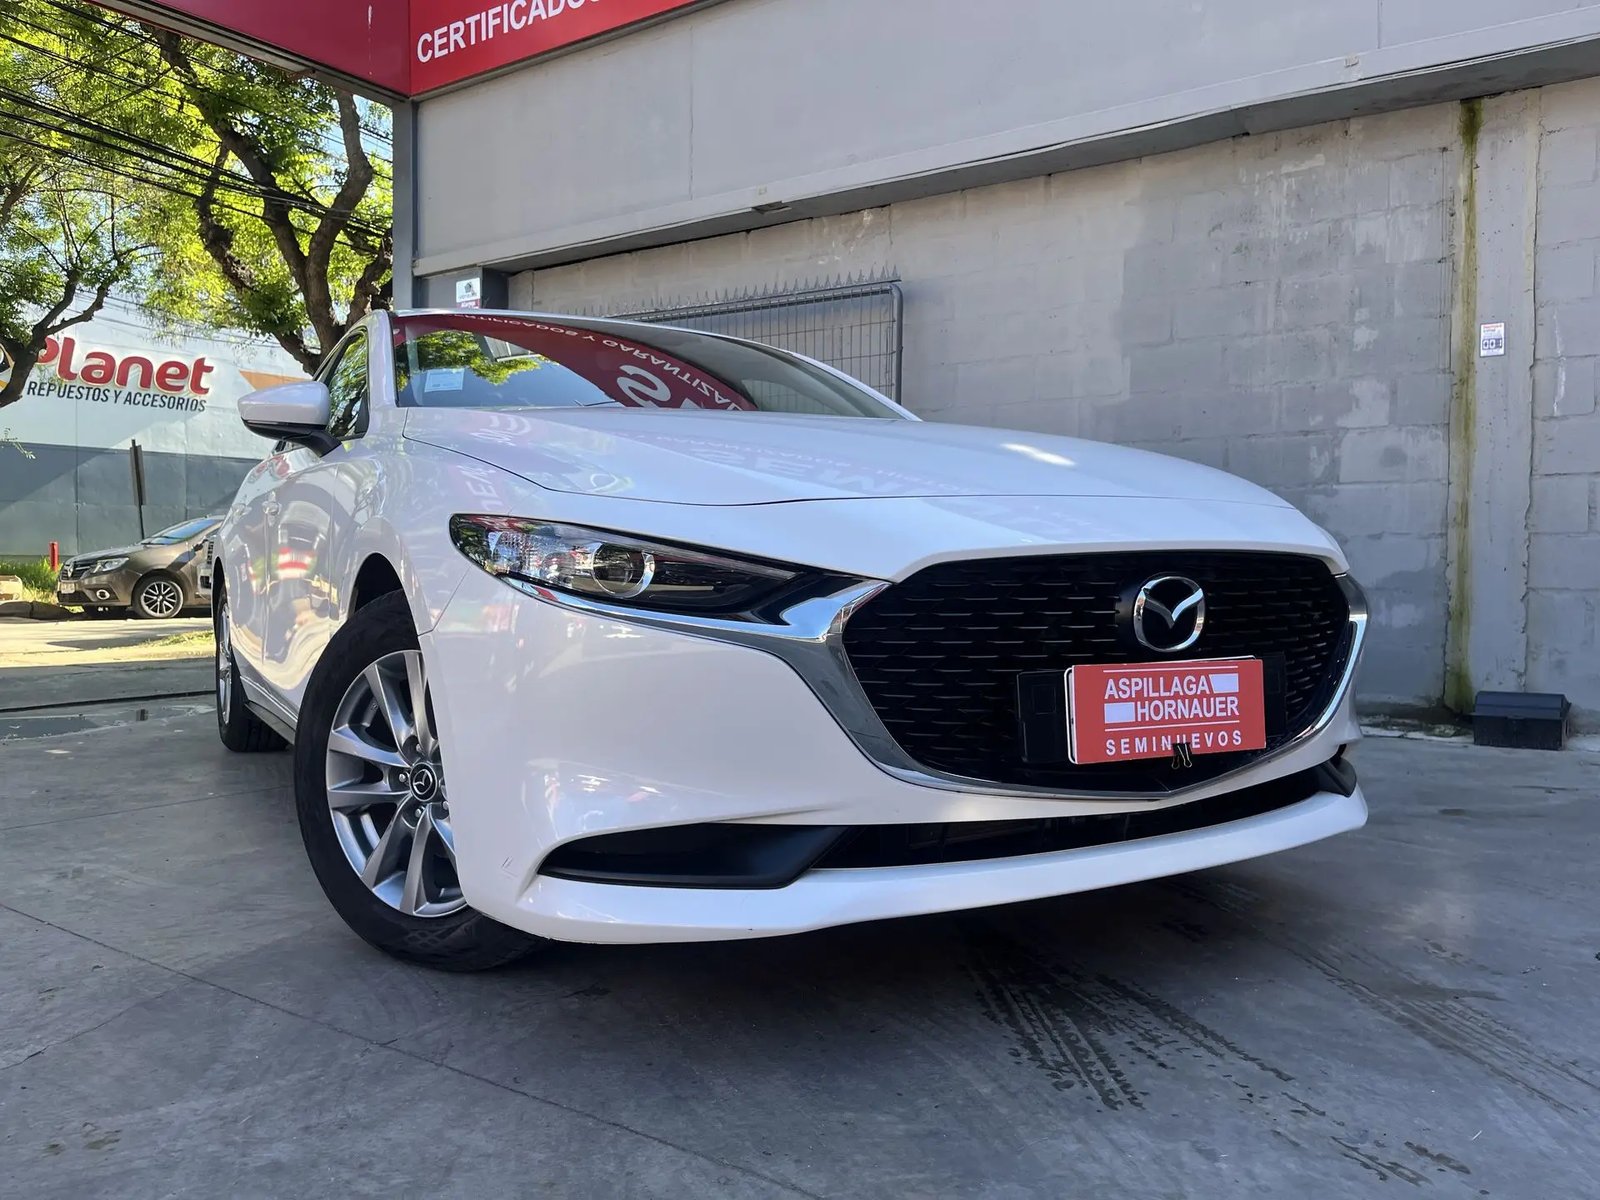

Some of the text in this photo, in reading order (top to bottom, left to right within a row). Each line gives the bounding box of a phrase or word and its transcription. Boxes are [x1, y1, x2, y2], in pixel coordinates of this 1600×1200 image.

[27, 380, 206, 413] REPUESTOS Y ACCESORIOS
[1104, 675, 1210, 699] ASPILLAGA
[1136, 697, 1239, 722] HORNAUER
